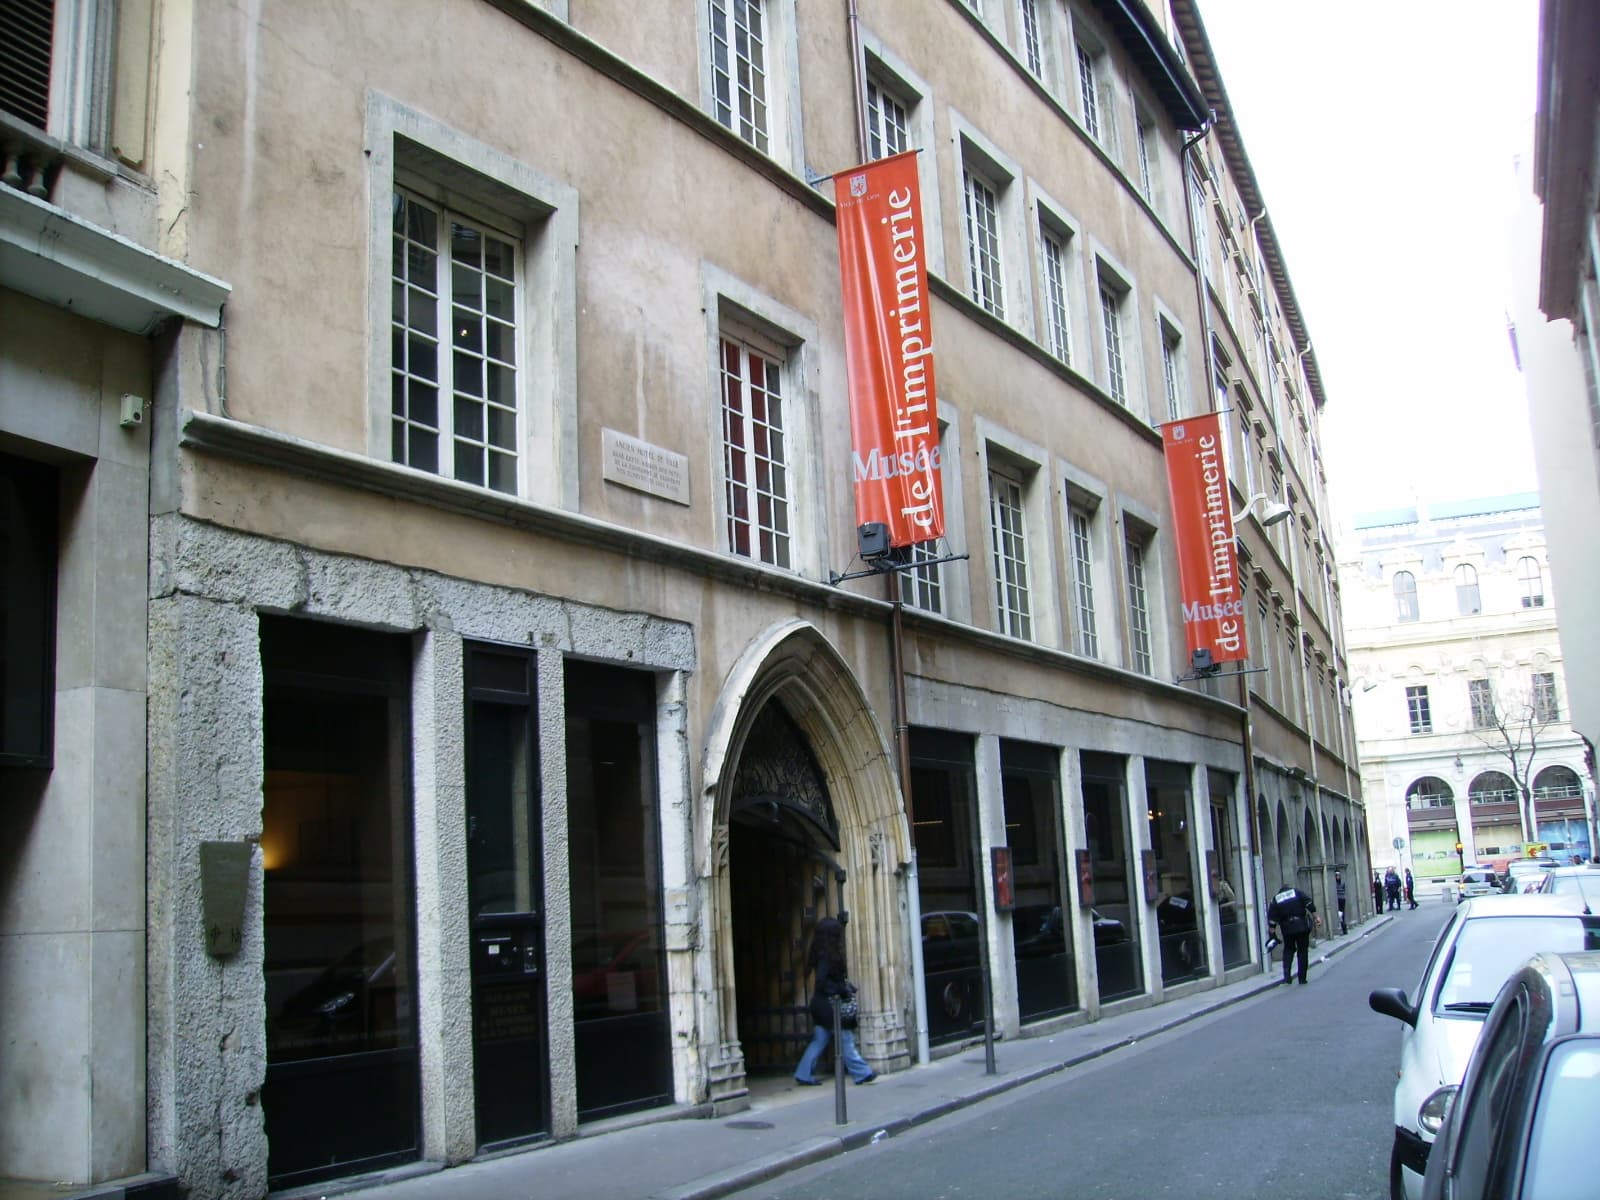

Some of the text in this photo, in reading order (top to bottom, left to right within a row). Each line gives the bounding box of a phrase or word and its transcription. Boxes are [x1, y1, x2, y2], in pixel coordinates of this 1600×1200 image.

[881, 186, 934, 527] de l'imprimerie
[852, 440, 942, 483] Musée
[1194, 434, 1239, 651] de l'imprimerie
[1181, 596, 1244, 623] Musée
